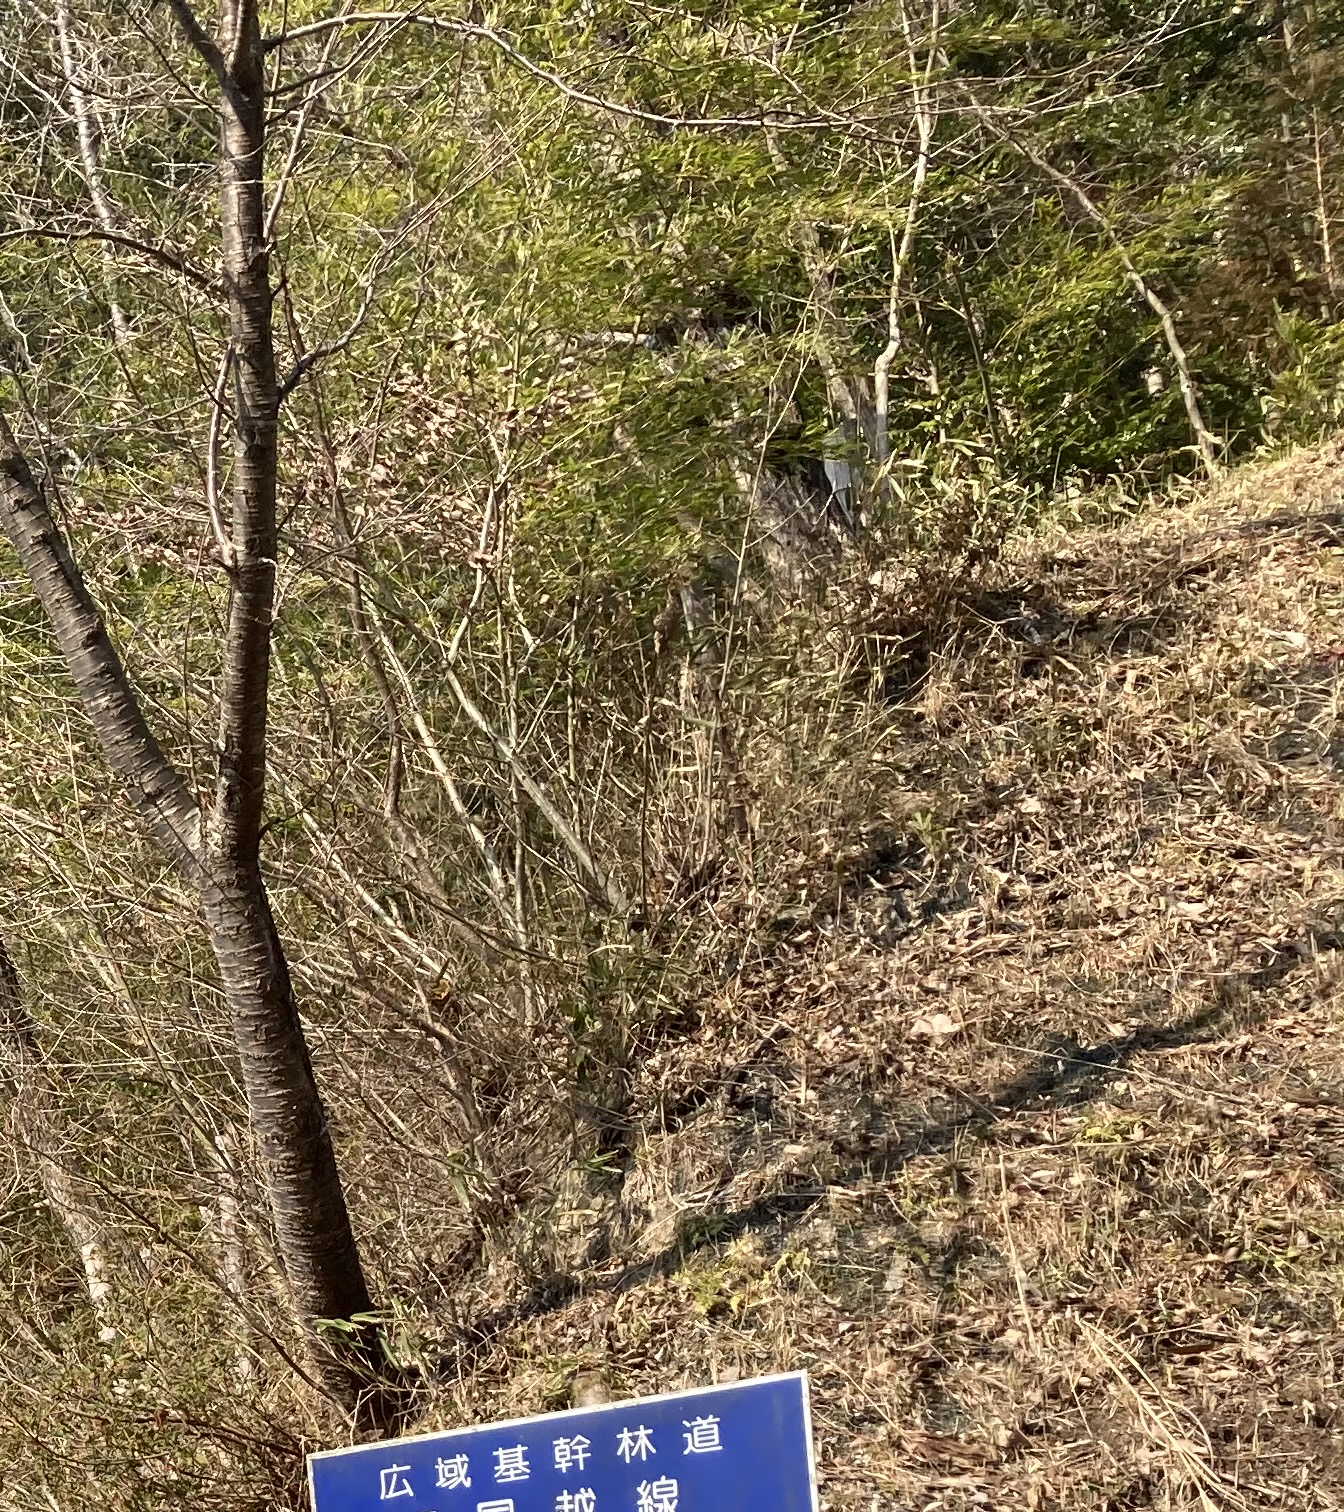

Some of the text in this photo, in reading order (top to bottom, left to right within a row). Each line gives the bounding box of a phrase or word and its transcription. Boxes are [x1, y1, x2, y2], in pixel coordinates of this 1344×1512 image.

[380, 1415, 724, 1500] 広域基幹林道
